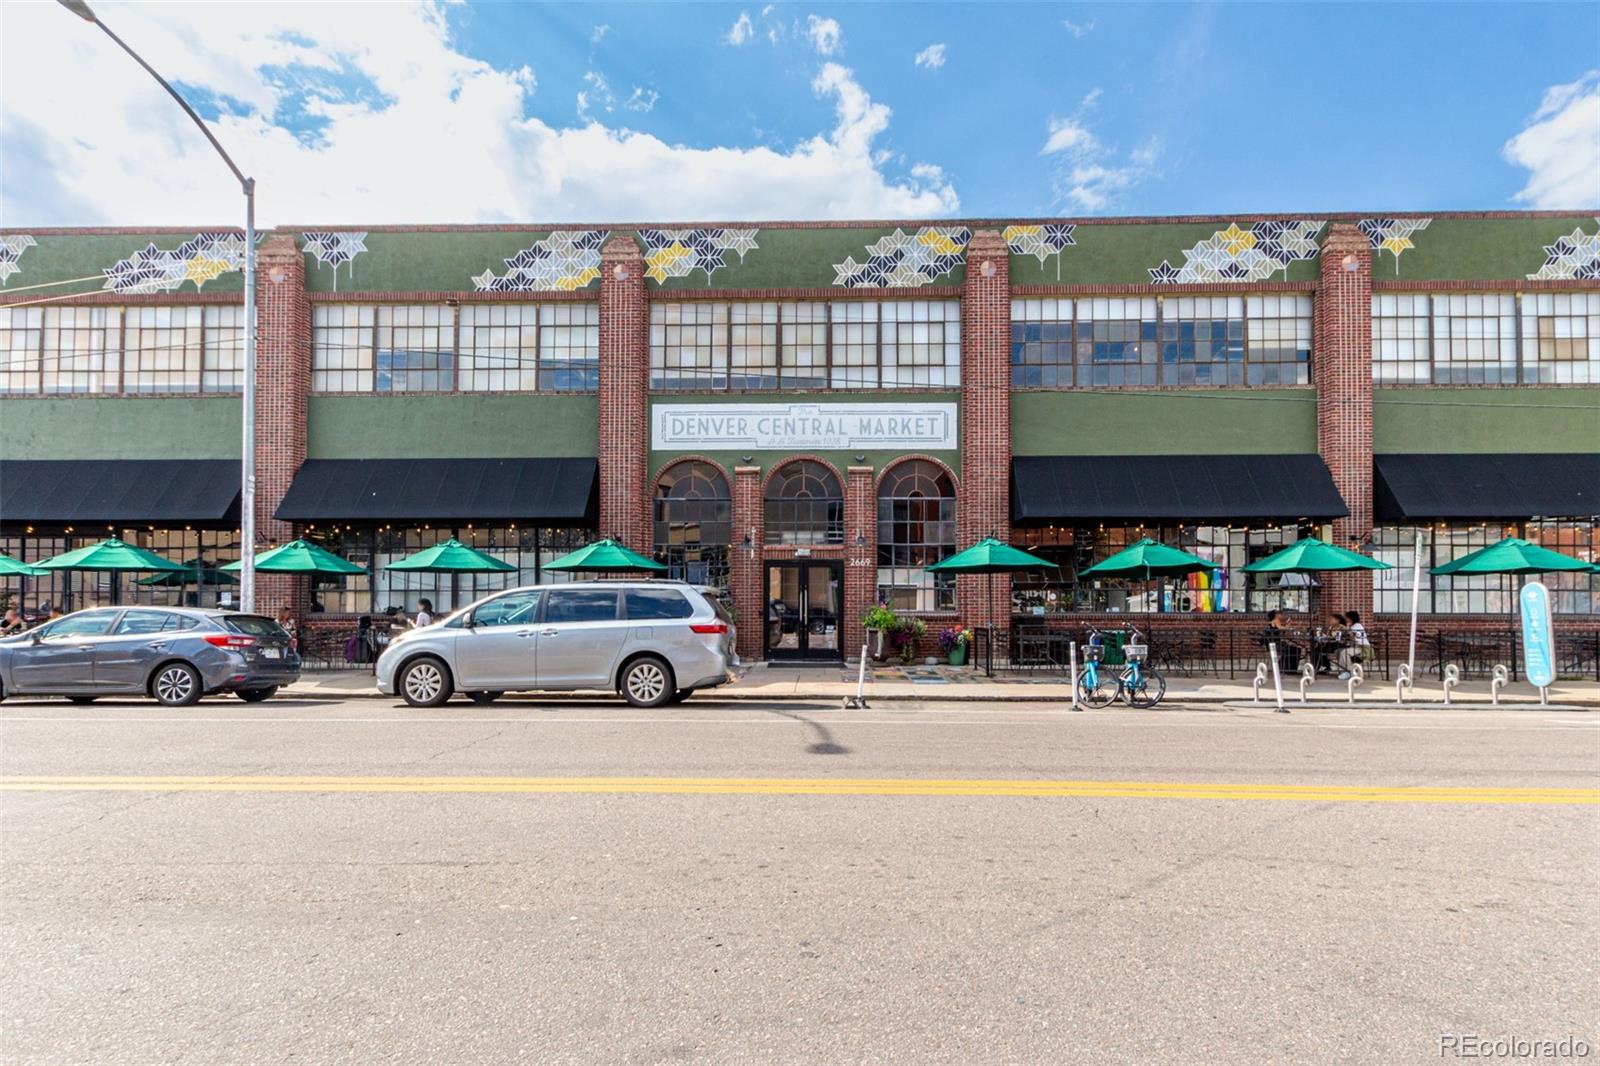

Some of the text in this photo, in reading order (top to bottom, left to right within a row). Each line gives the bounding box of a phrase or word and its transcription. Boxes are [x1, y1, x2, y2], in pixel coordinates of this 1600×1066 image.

[671, 417, 939, 436] DENVER CENTRAL MARKET
[850, 558, 871, 567] 2669
